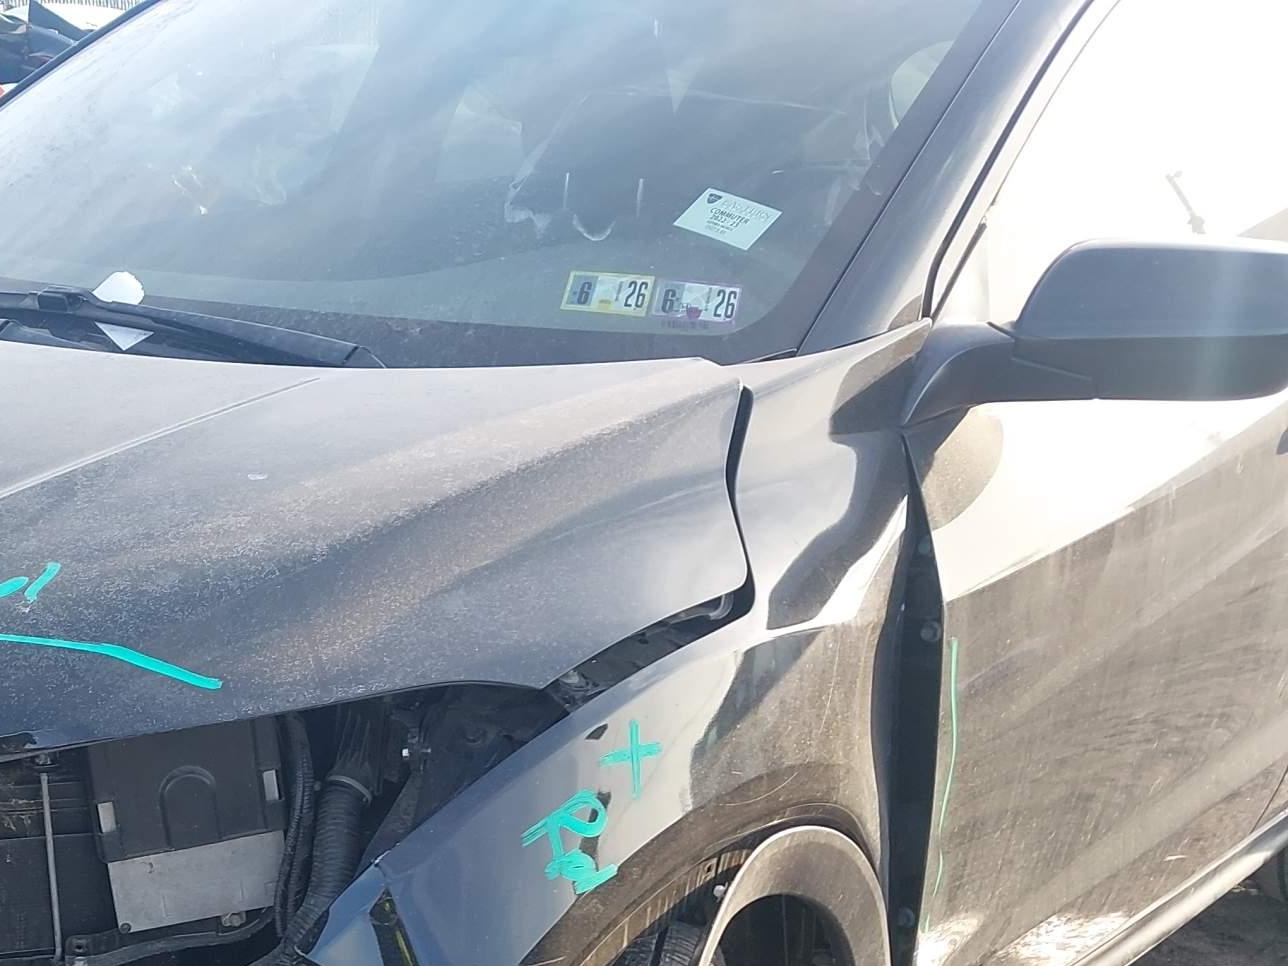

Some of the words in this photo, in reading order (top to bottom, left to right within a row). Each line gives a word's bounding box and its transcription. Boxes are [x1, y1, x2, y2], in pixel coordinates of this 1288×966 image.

[710, 207, 751, 225] COMMUTER
[576, 281, 593, 305] 6
[623, 280, 649, 309] 26
[661, 288, 677, 314] 6
[713, 288, 738, 319] 26
